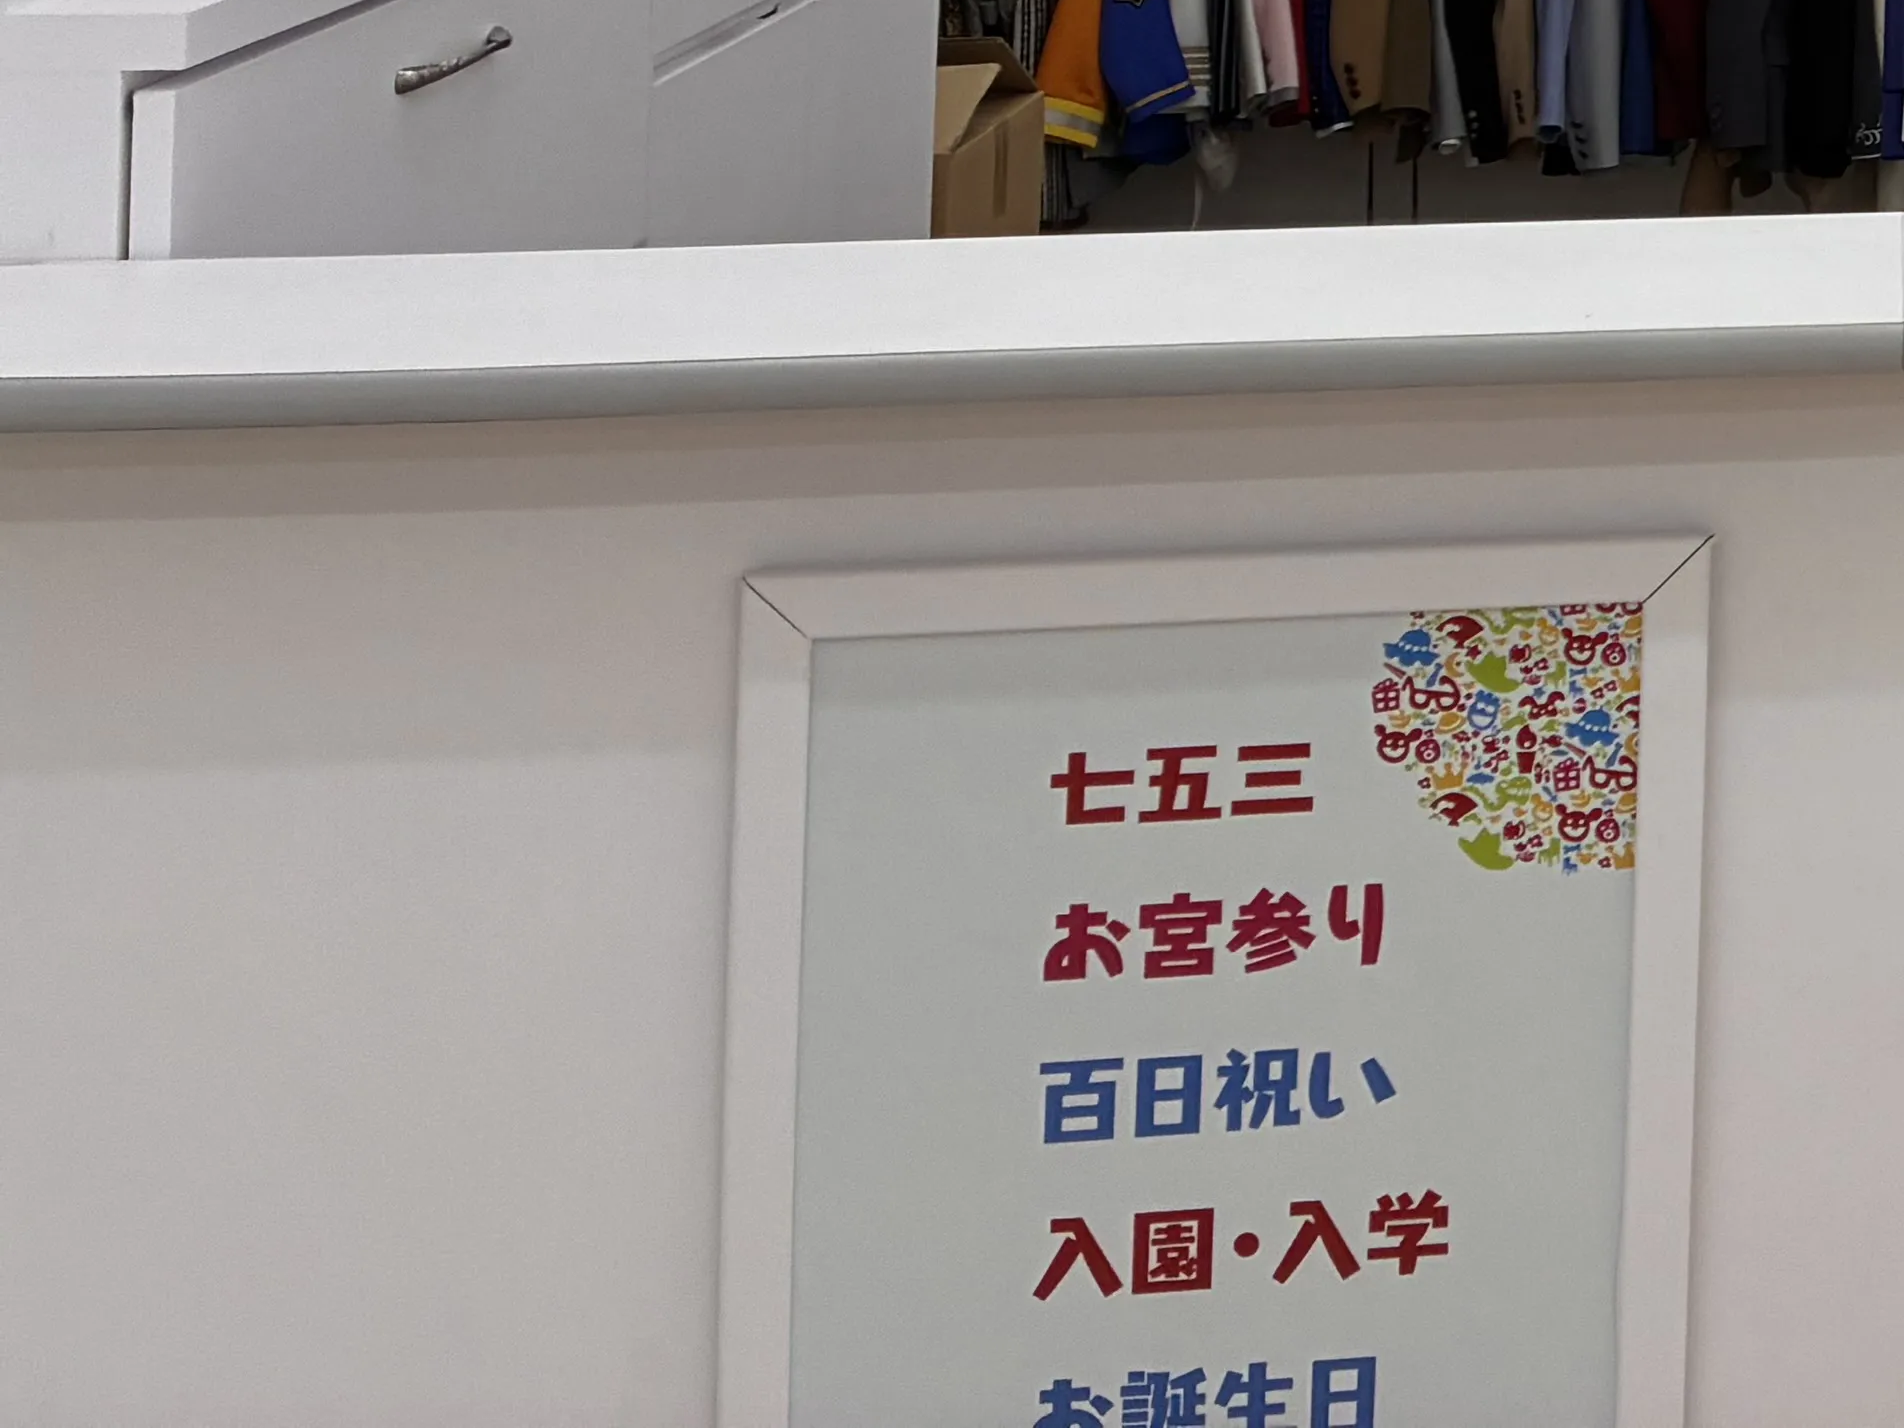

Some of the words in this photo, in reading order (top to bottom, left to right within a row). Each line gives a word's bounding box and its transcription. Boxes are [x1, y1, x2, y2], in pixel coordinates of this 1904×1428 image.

[1049, 741, 1315, 826] 七五三
[1043, 882, 1386, 982] お宮参り
[1039, 1046, 1397, 1144] 百日祝い
[1031, 1188, 1450, 1301] 入園・入学
[1032, 1355, 1379, 1428] お誕生日
